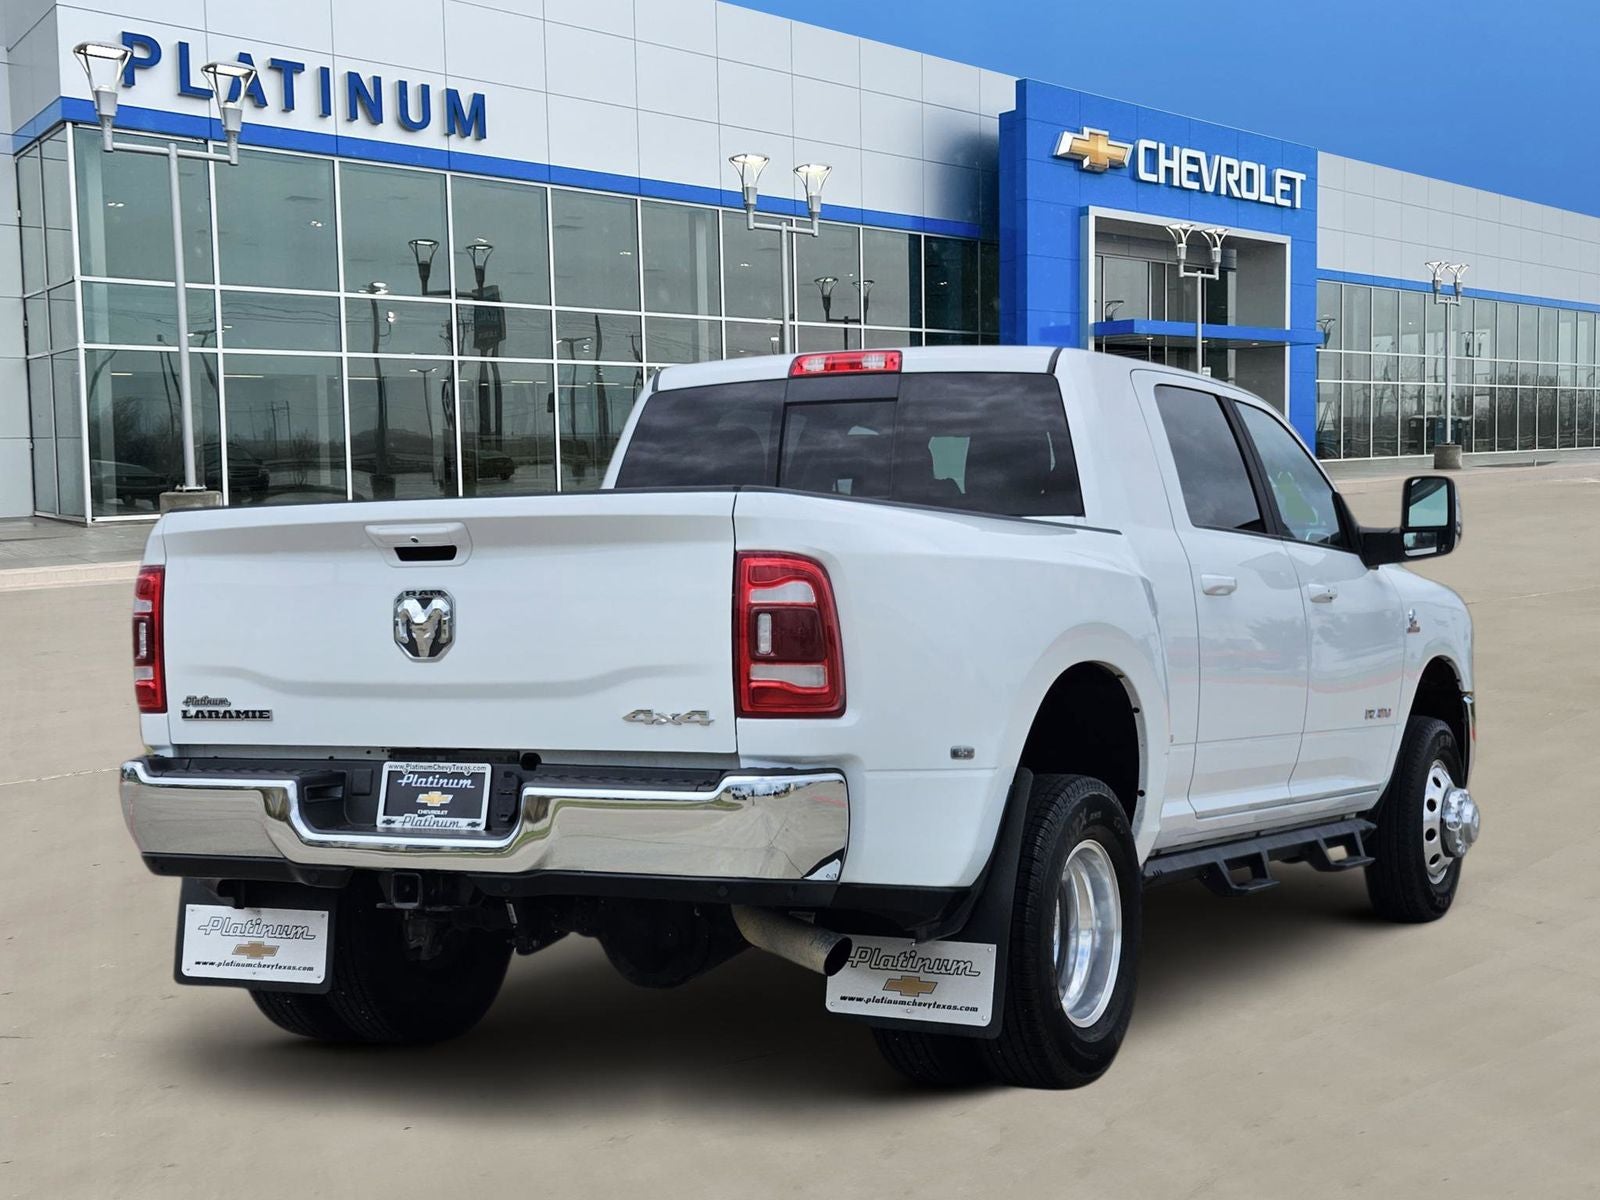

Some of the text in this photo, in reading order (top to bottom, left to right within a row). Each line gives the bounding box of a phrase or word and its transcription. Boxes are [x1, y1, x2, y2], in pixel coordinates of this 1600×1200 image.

[121, 31, 487, 140] PLATINUM
[1136, 138, 1306, 209] CHEVROLET
[182, 695, 232, 707] Platinum
[181, 709, 271, 720] LARAMIE
[397, 774, 475, 789] Platinum
[398, 815, 464, 828] Platinum
[198, 916, 316, 940] Platinum
[195, 960, 314, 972] www.platinumchevytexas.com
[847, 946, 981, 976] Platinum
[839, 994, 979, 1012] www.platinumchevytexas.com
